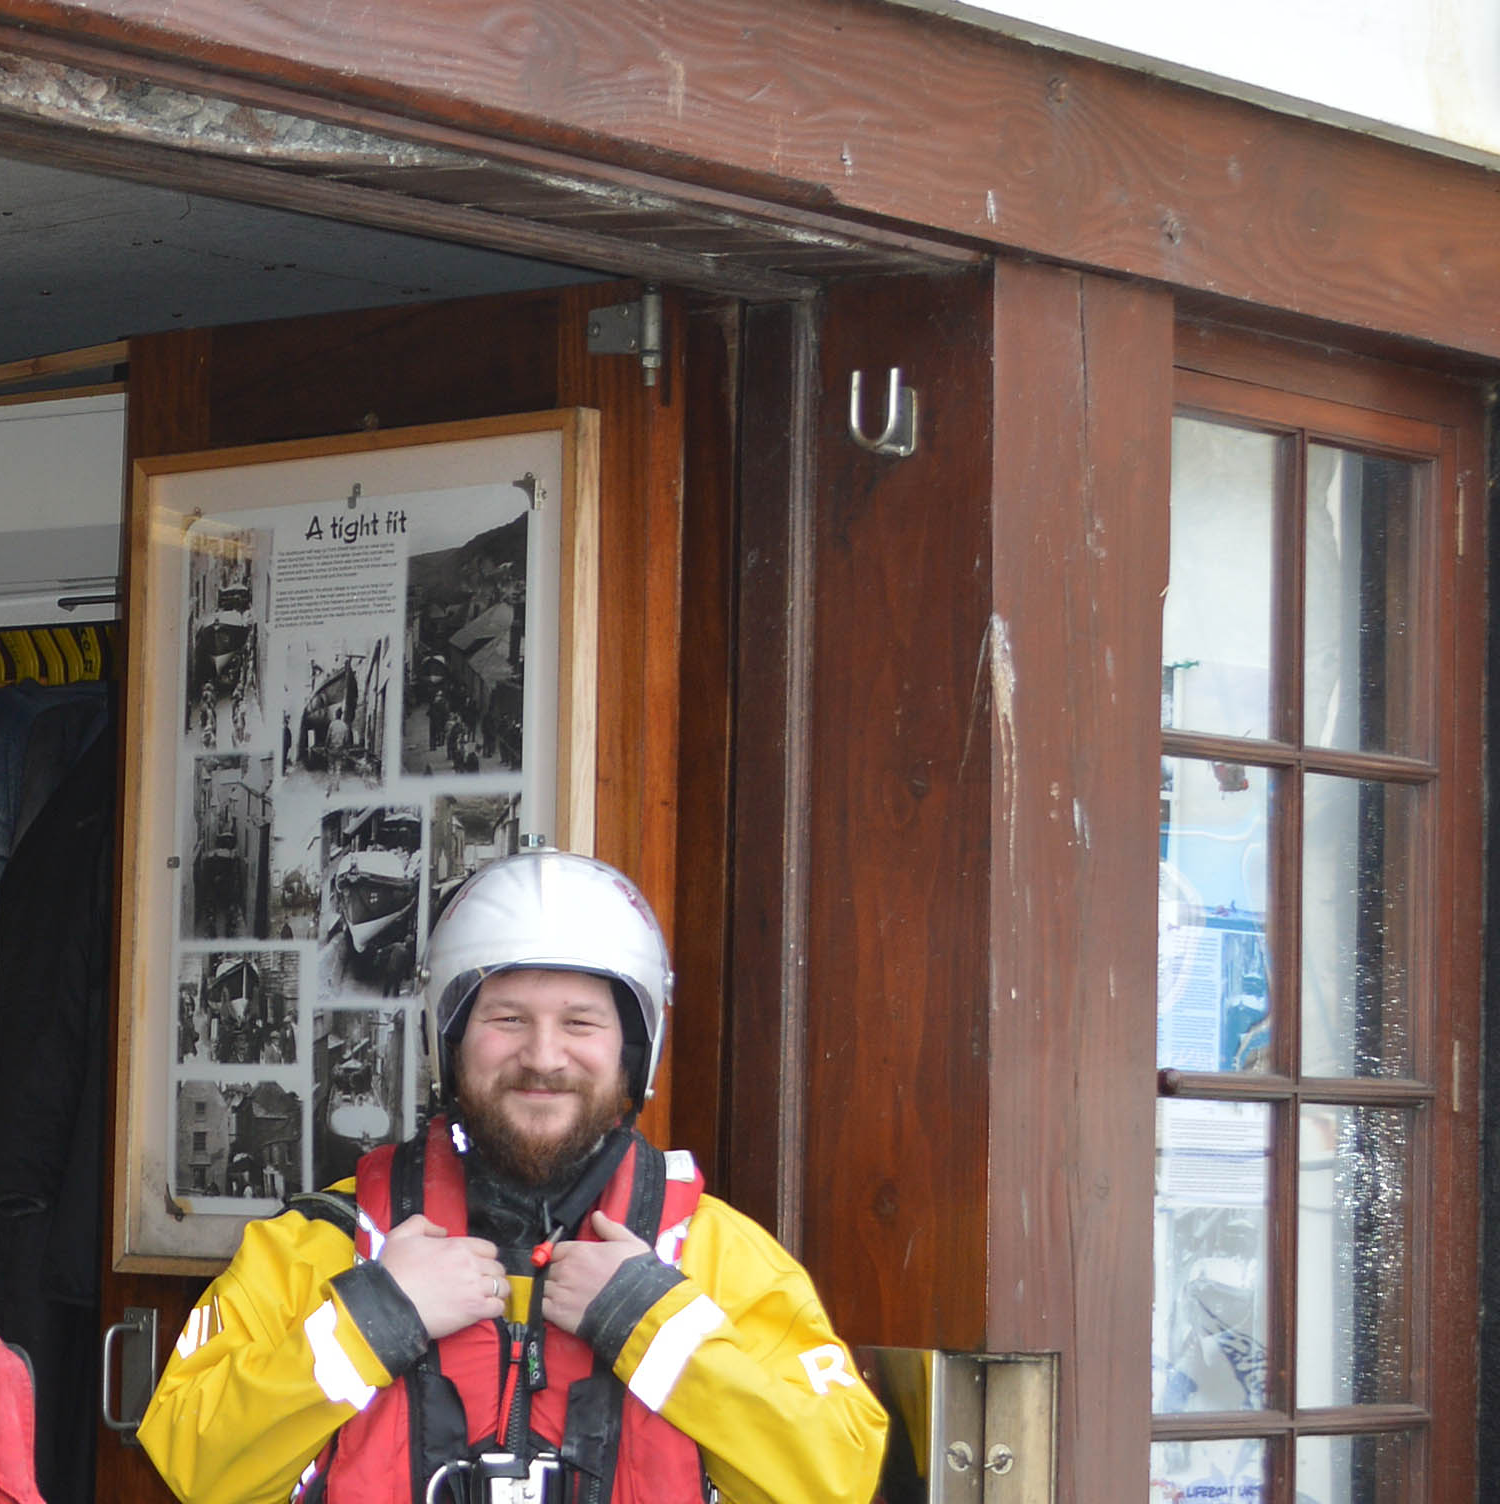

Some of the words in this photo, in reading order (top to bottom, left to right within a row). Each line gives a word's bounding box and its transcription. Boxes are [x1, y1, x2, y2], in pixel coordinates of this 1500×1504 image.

[305, 515, 323, 540] A
[330, 512, 379, 544] tight
[385, 510, 407, 534] fit
[797, 1343, 857, 1395] R
